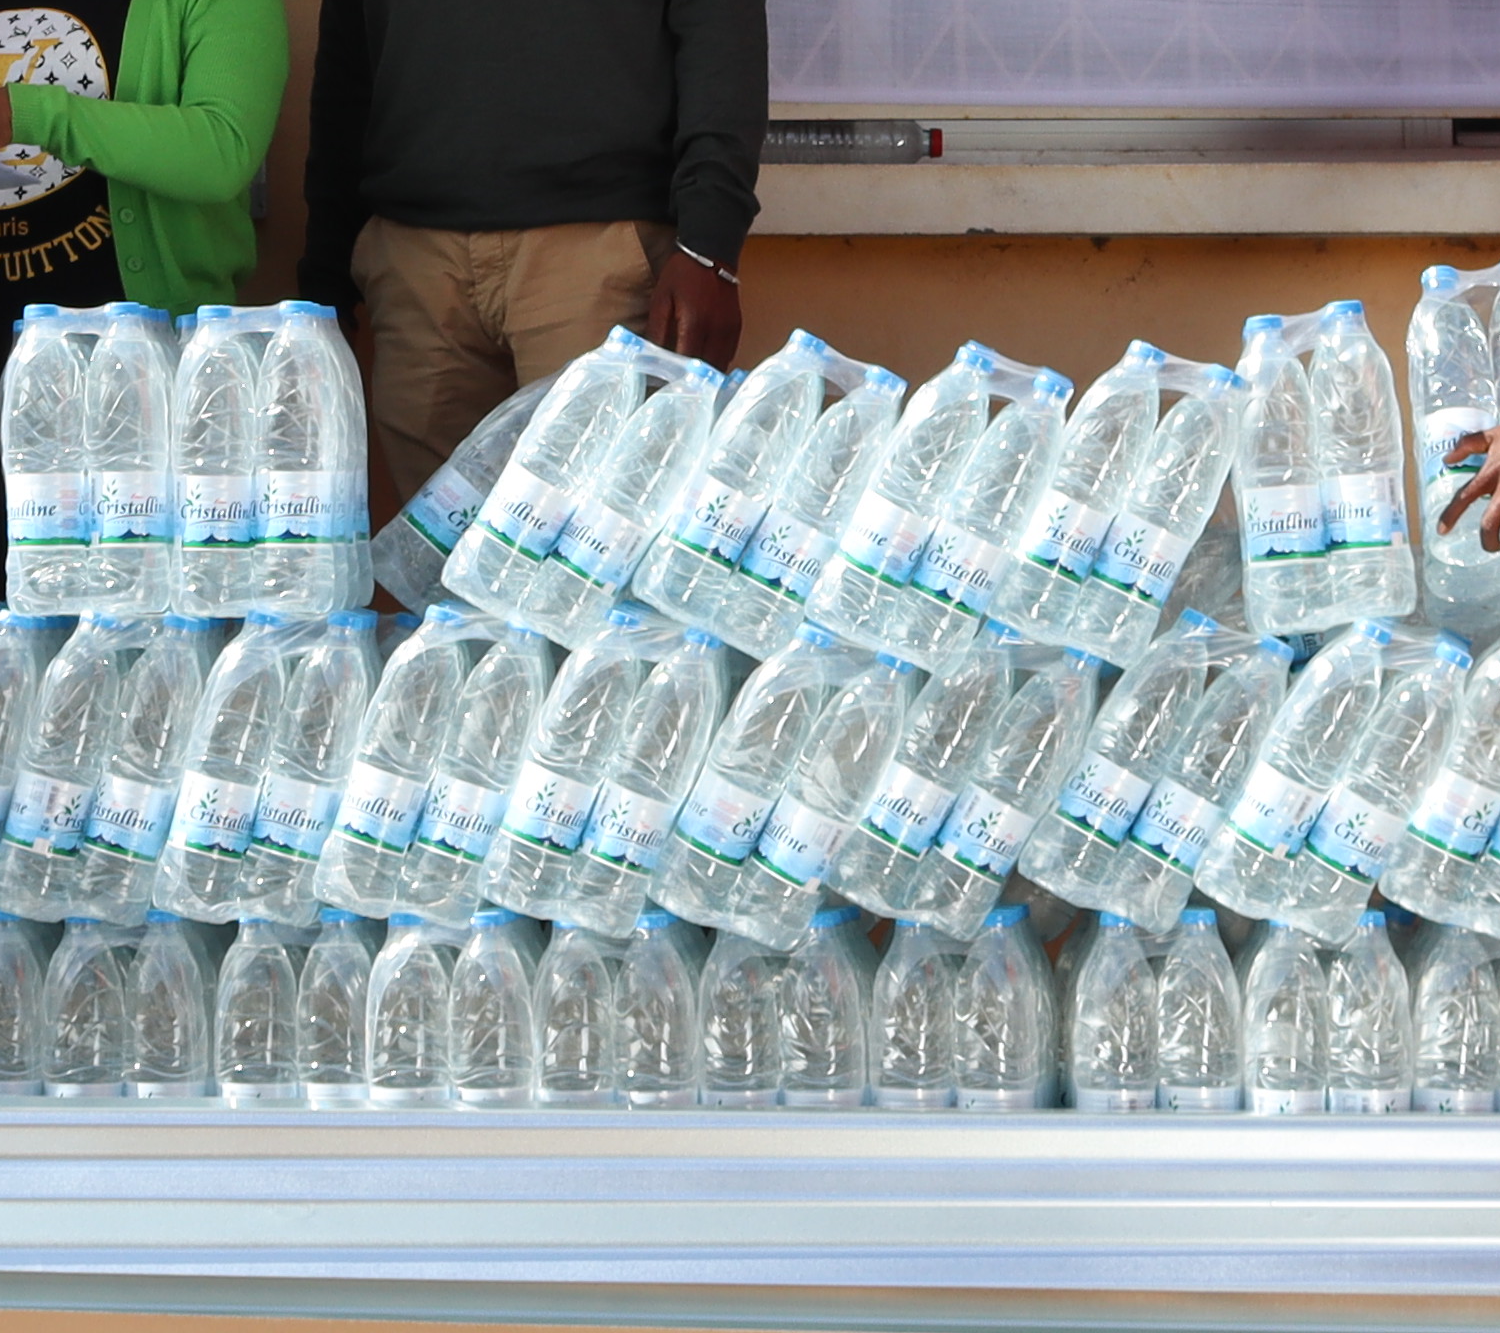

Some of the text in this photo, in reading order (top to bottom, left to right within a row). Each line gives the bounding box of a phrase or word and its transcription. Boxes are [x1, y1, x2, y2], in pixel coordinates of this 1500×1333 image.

[1250, 512, 1318, 532] ristalline
[759, 536, 821, 579] Cristalli
[92, 804, 156, 832] ristalline
[260, 803, 324, 832] ristalline
